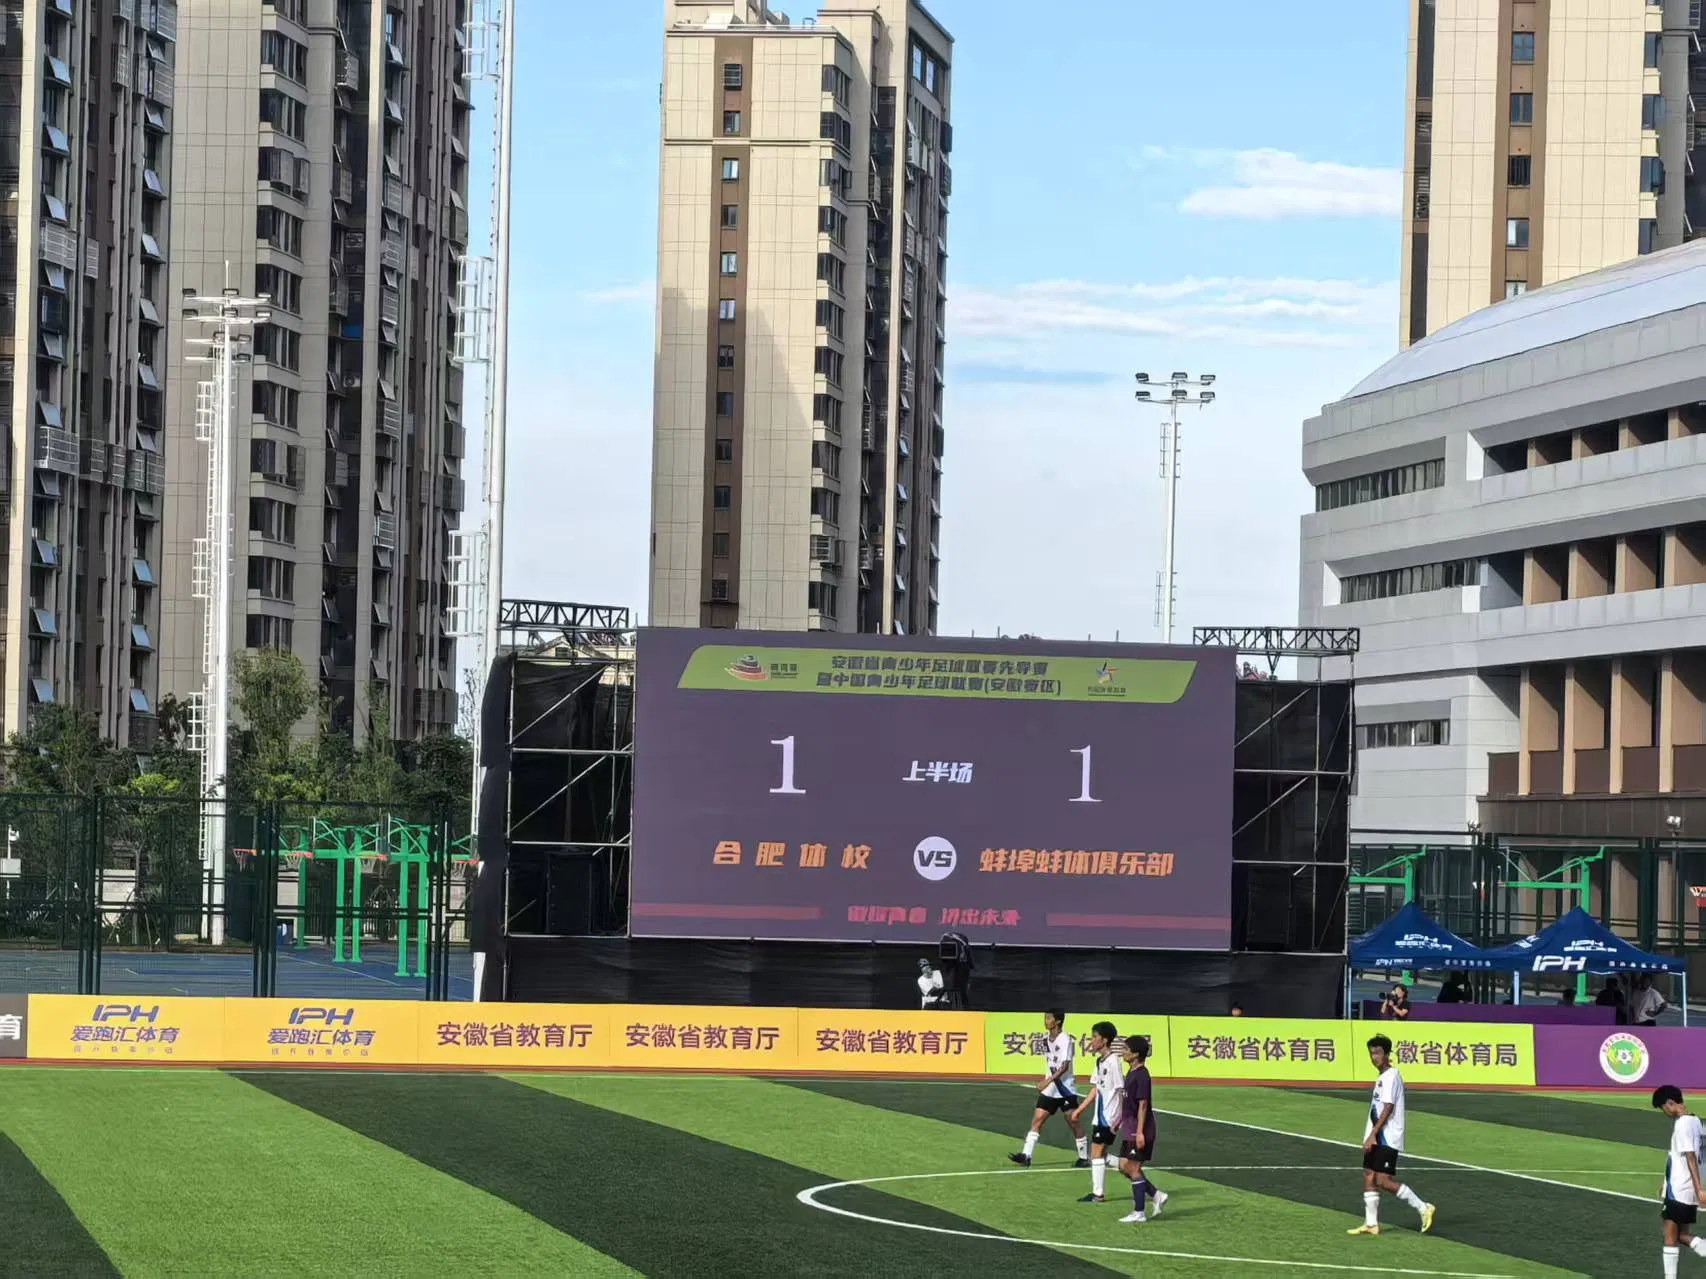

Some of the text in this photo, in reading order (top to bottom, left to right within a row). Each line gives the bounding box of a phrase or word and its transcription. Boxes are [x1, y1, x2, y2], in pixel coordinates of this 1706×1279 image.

[769, 735, 807, 795] 1
[902, 761, 974, 785] 上半场
[1069, 744, 1103, 804] 1
[712, 840, 873, 871] 合肥体校
[917, 850, 953, 868] VS
[979, 848, 1175, 878] 蚌埠蚌体俱乐部
[1531, 955, 1588, 972] IPH
[92, 1004, 160, 1023] IPH
[288, 1007, 355, 1026] IPH
[70, 1025, 181, 1044] 爱跑汇体育
[267, 1028, 377, 1046] 爱跑汇体育
[436, 1021, 594, 1050] 安徽省教育厅
[625, 1023, 780, 1052] 安徽省教育厅
[816, 1028, 969, 1057] 安徽省教育厅
[1187, 1035, 1336, 1062] 安徽省体育局
[1390, 1040, 1518, 1067] 徽省体育局
